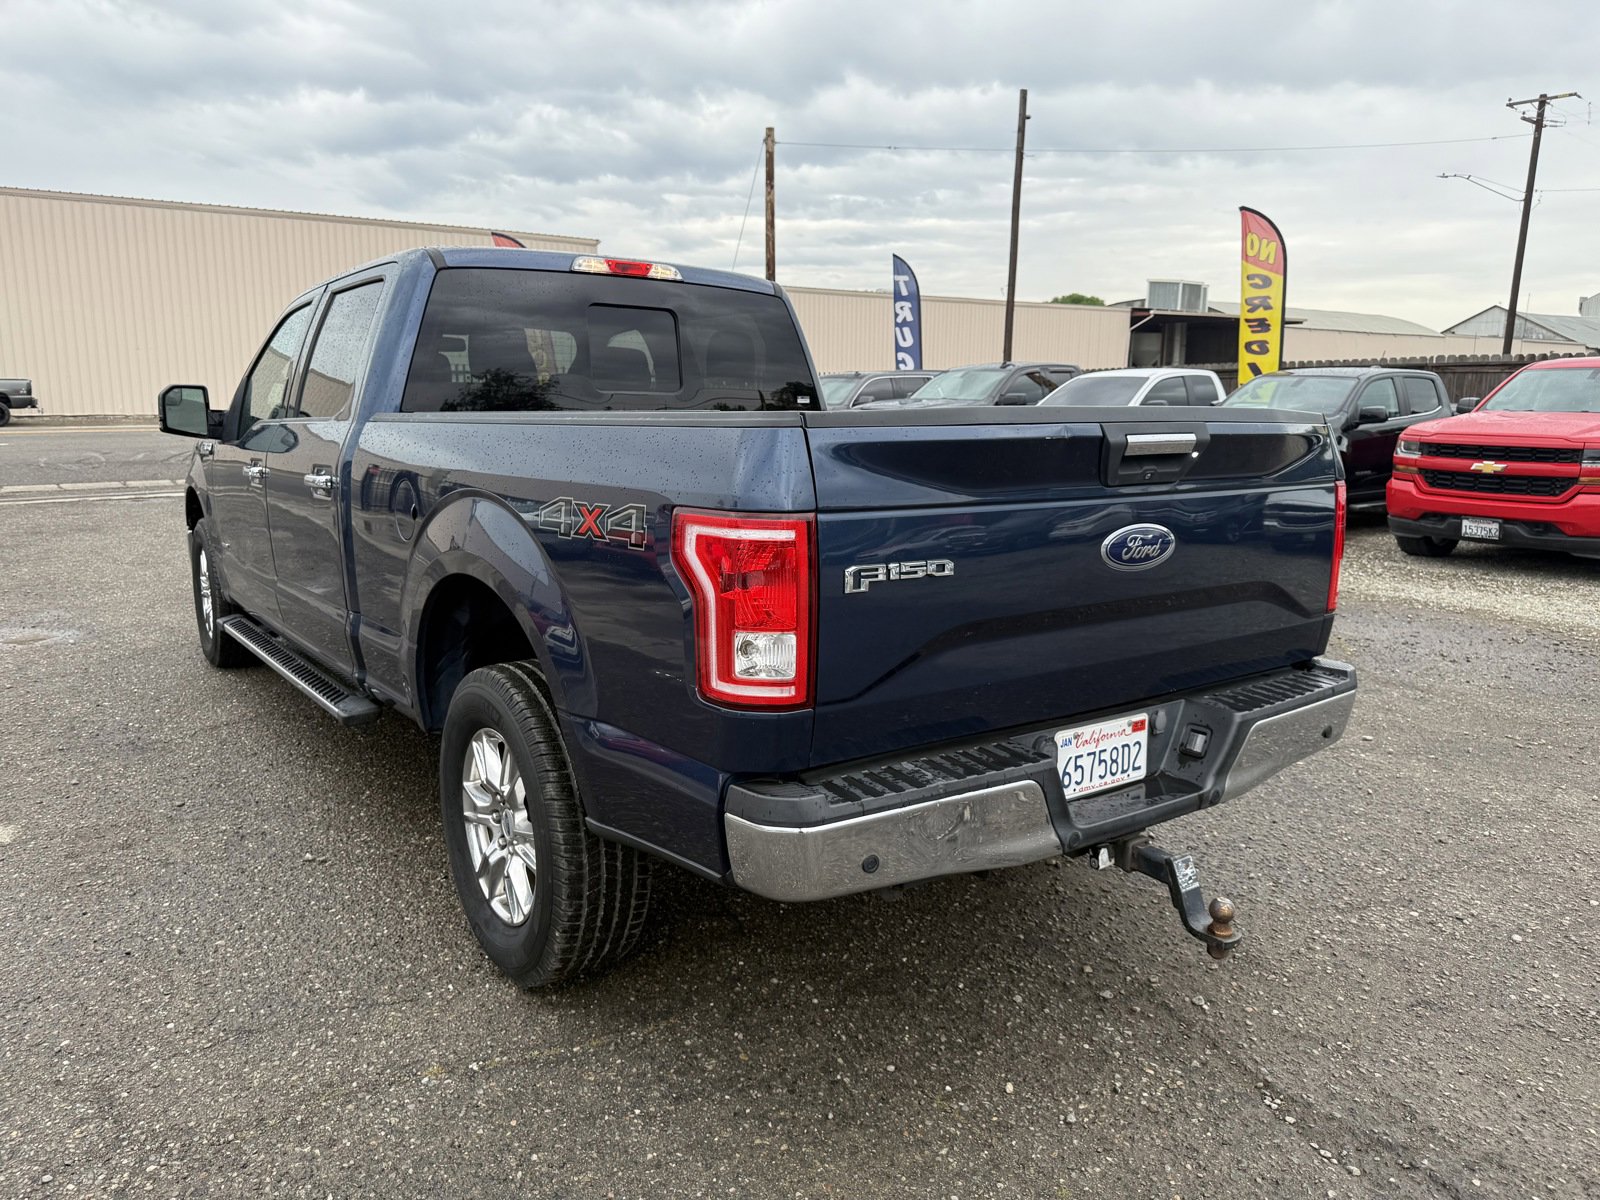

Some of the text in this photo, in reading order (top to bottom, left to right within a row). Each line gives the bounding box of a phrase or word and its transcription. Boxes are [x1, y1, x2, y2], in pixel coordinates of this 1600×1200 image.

[1122, 534, 1161, 560] Ford
[1061, 736, 1073, 748] JAN
[1075, 728, 1131, 749] California
[1061, 740, 1142, 789] 65758D2
[1078, 776, 1126, 793] dmv.ca.gov
